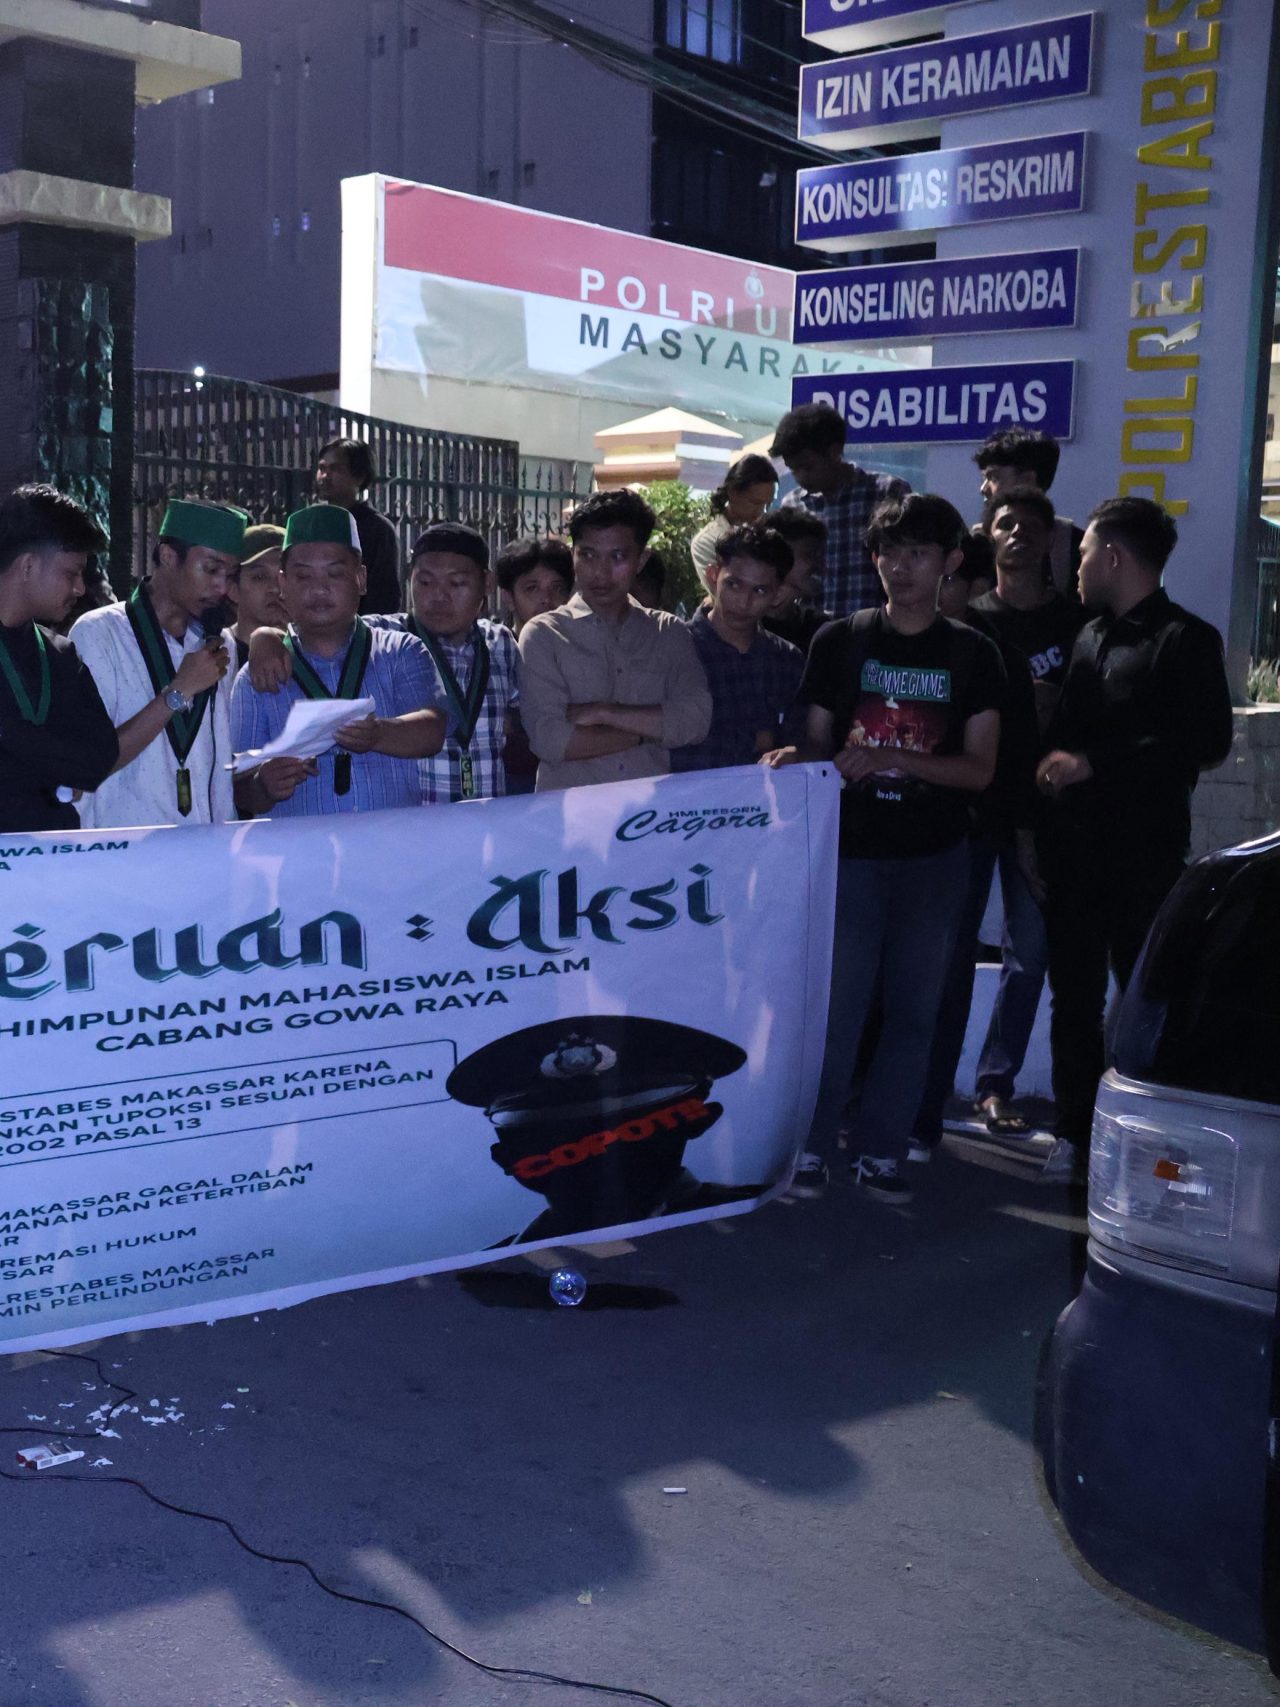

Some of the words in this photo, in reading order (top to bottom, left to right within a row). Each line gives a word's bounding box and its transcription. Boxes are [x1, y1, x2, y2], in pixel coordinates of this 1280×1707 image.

[816, 71, 871, 119] IZIN
[881, 35, 1070, 110] KERAMAIAN
[956, 151, 1074, 205] RESKRIM
[580, 267, 733, 329] POLRI
[800, 278, 934, 327] KONSELING
[942, 268, 1066, 317] NARKOBA
[579, 313, 865, 378] MASYARAK
[616, 810, 773, 842] Cagora
[669, 810, 698, 818] HMI
[702, 806, 761, 815] REBORN
[52, 840, 129, 854] ISLAM
[466, 863, 725, 955] Aksi
[240, 970, 475, 1011] MAHASISWA
[486, 957, 590, 982] ISLAM
[96, 1018, 272, 1052] CABANG
[284, 1002, 404, 1029] GOWA
[415, 990, 509, 1014] RAYA
[87, 1100, 211, 1127] TUPOKSI
[220, 1085, 314, 1108] SESUAI
[324, 1069, 433, 1094] DENGAN
[121, 1075, 275, 1106] MAKASSAR
[284, 1060, 392, 1083] KARENA
[75, 1124, 166, 1145] PASAL
[175, 1117, 202, 1131] 13
[97, 1200, 150, 1218] DAN
[158, 1175, 306, 1207] KETERTIBAN
[138, 1177, 223, 1198] GAGAL
[231, 1162, 313, 1184] DALAM
[106, 1227, 197, 1251] HUKUM
[142, 1248, 275, 1279] MAKASSAR
[51, 1265, 248, 1309] PERLINDUNGAN
